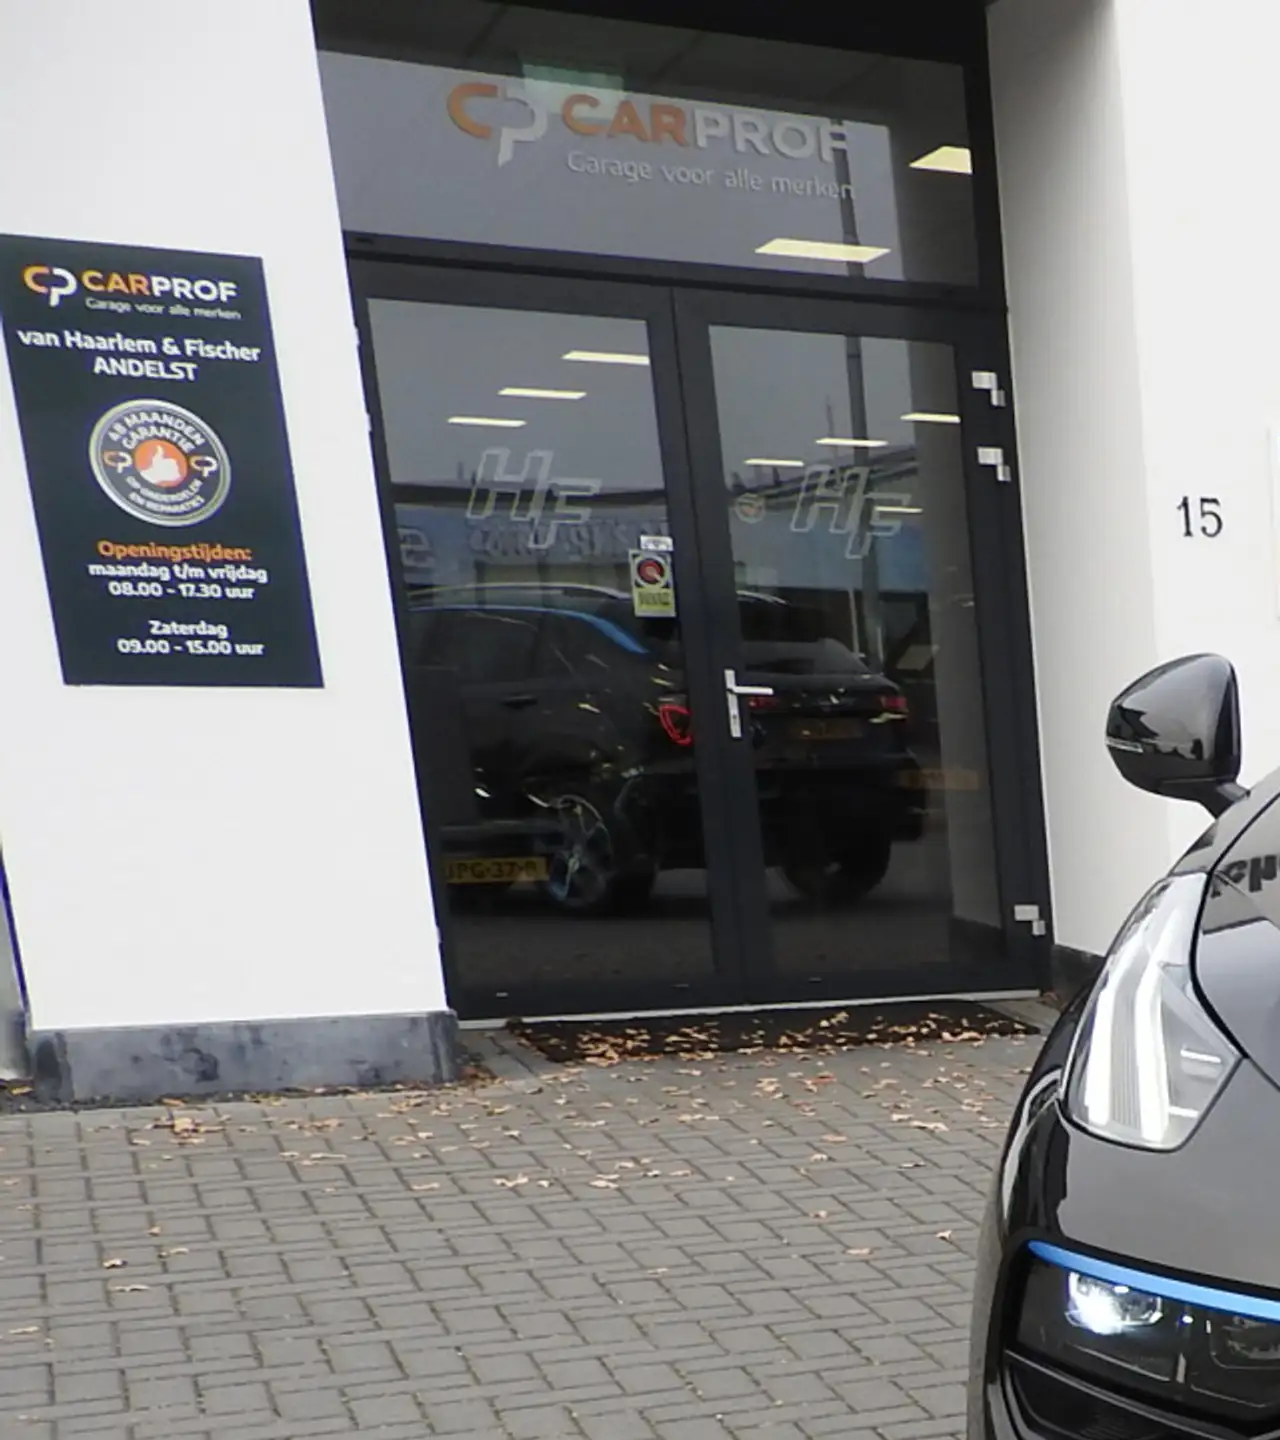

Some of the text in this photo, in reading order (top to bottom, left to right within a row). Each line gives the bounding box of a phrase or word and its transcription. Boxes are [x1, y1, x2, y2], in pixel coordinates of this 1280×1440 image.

[562, 93, 849, 163] CARPROF
[567, 150, 856, 200] Garage voor alle merken
[81, 270, 237, 302] CARPROF
[85, 298, 132, 314] Garage
[134, 303, 165, 315] voor
[194, 307, 242, 320] merken
[17, 330, 261, 361] van Haarlem & Fischer
[93, 357, 198, 381] ANDELST
[121, 426, 196, 453] GARANTIE
[123, 411, 205, 445] MAANDEN
[1177, 496, 1223, 538] 15
[97, 540, 252, 562] Openingstijden:
[88, 562, 268, 583] maandag t/m vrijdag
[108, 581, 163, 596] 08.00
[178, 583, 222, 598] 17.30
[225, 587, 255, 599] uur
[149, 620, 228, 639] Zaterdag
[117, 639, 170, 653] 09.00
[185, 640, 232, 655] 15.00
[234, 643, 265, 655] uur
